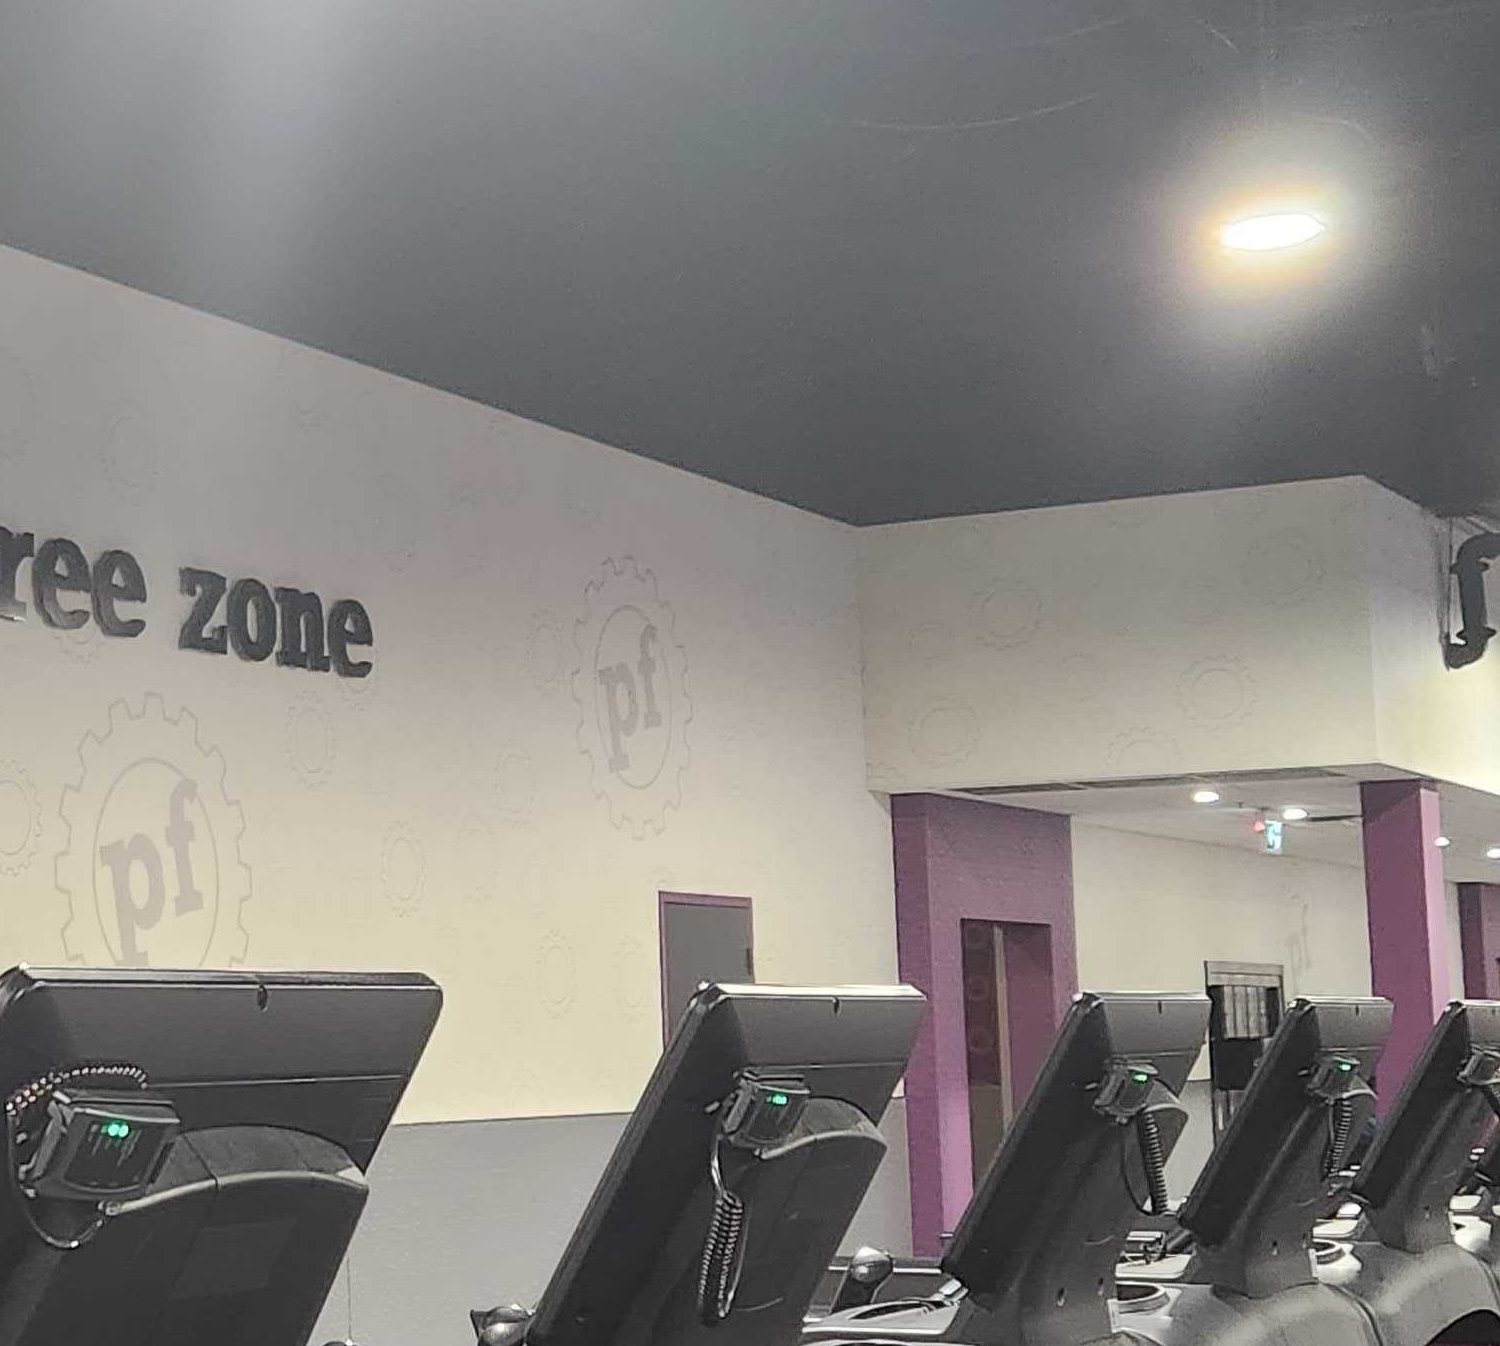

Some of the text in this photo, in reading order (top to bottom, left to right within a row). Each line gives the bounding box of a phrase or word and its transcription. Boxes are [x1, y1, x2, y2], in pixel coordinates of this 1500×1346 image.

[178, 566, 374, 678] zone
[598, 624, 663, 774] pf
[100, 777, 205, 967] pf
